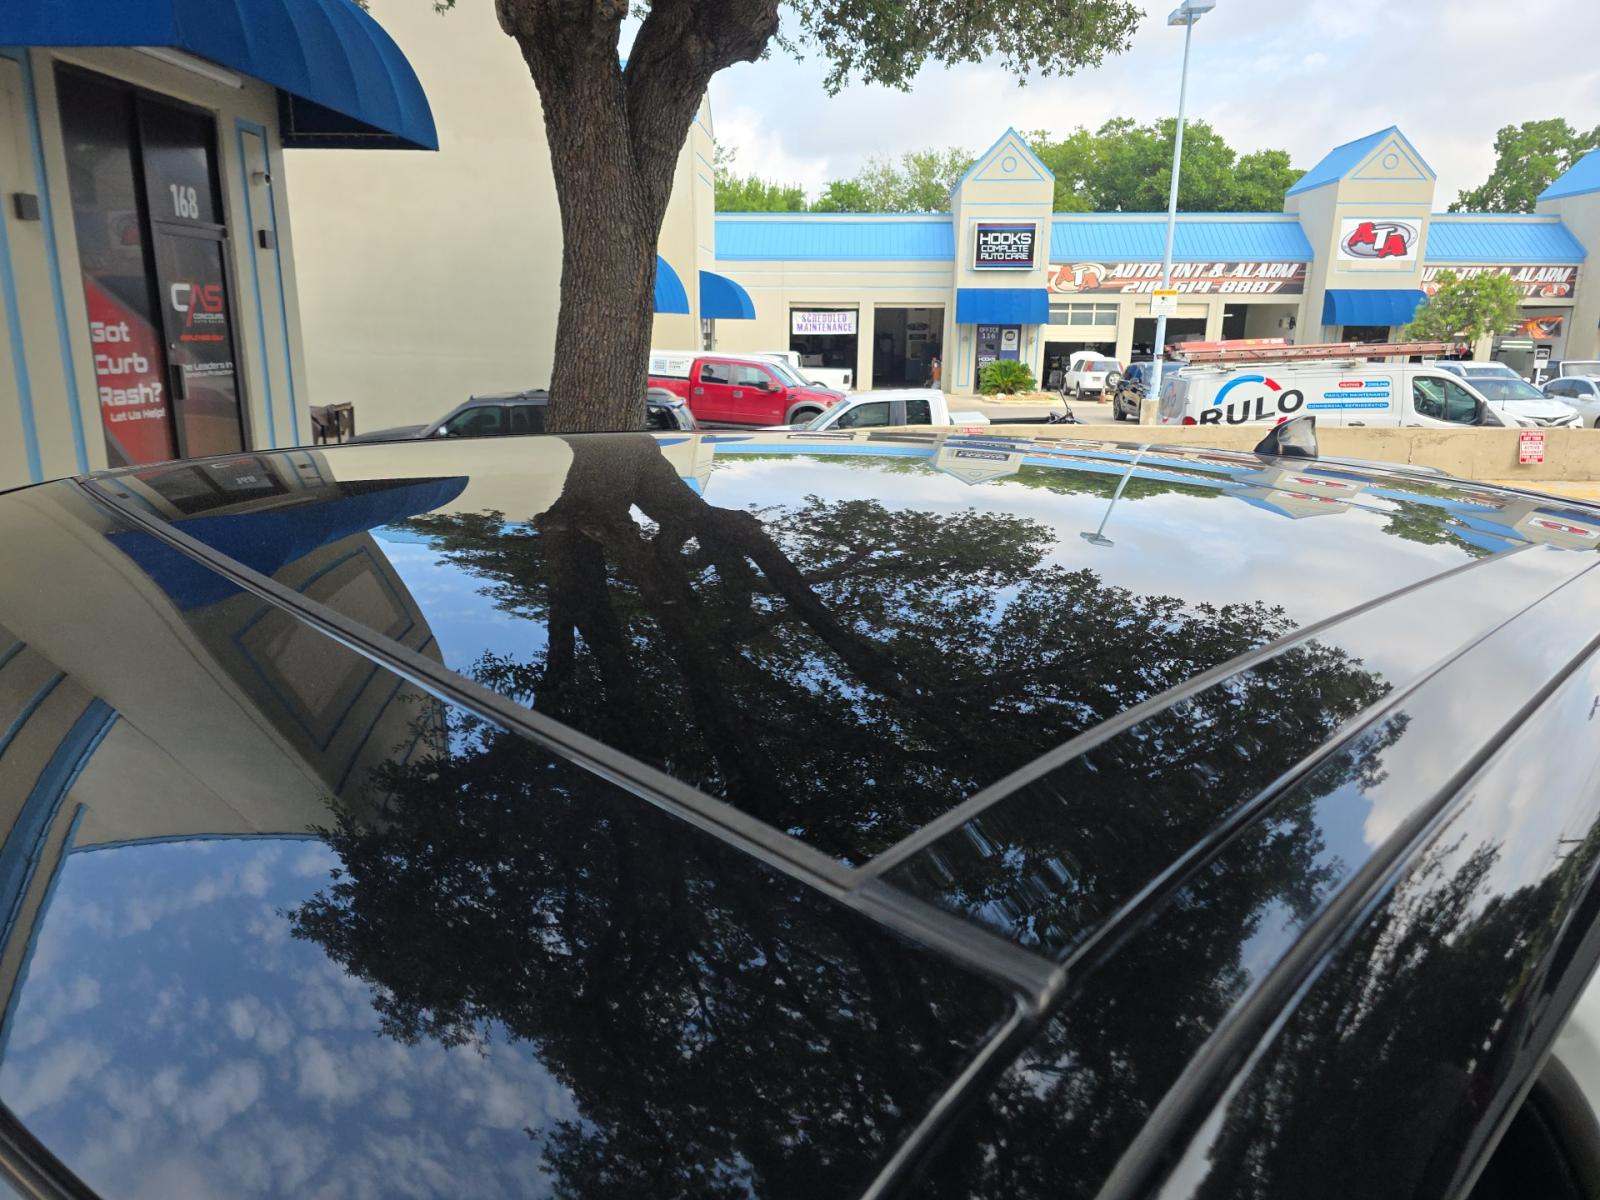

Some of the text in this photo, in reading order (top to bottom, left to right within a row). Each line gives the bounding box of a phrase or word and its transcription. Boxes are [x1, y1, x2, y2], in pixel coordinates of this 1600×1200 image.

[170, 184, 199, 219] 168
[980, 232, 1032, 245] HOOKS
[1347, 221, 1408, 258] ATA
[980, 244, 1030, 252] COMPLETE
[980, 252, 1029, 260] AUTO CARE
[1108, 263, 1299, 278] AUTO TINT & ALARM
[1511, 266, 1573, 282] ALARM
[171, 283, 223, 327] CAS
[801, 313, 848, 323] SCHEDULED
[796, 323, 852, 332] MAINTENANCE
[95, 352, 148, 375] Curb
[99, 382, 162, 406] Rash?
